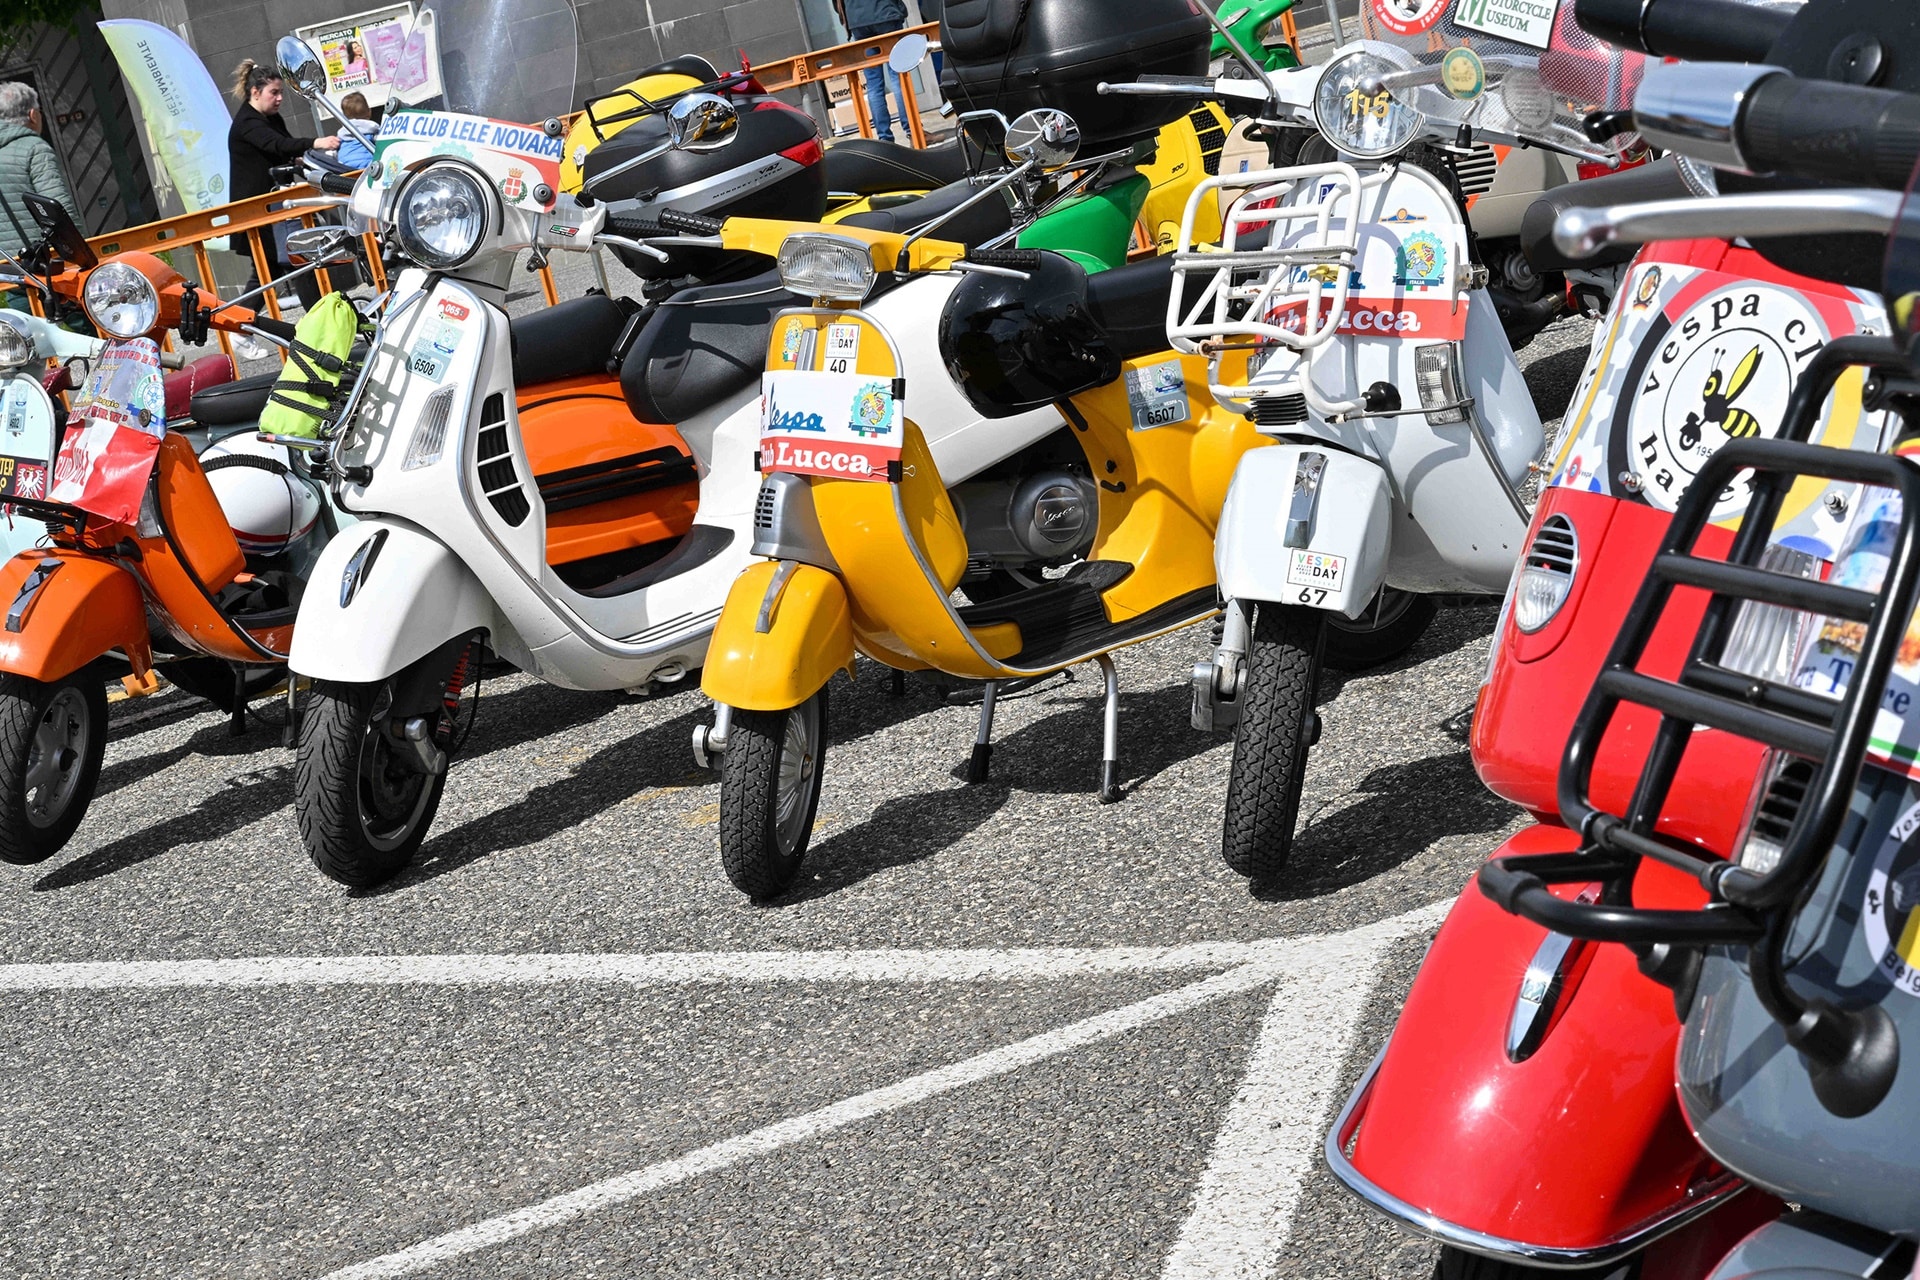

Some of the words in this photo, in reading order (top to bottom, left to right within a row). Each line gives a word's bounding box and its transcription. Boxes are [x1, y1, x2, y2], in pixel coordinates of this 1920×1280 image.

[334, 82, 343, 90] 14
[412, 115, 448, 138] CLUB
[450, 119, 486, 143] LELE
[490, 126, 563, 158] NOVARA
[831, 327, 855, 339] VESPA
[838, 338, 854, 349] DAY
[1642, 293, 1761, 396] vespa
[414, 358, 436, 376] 6508
[830, 359, 847, 374] 40
[1126, 367, 1151, 379] VESPA
[1128, 381, 1154, 394] DAYS
[768, 382, 827, 433] Vespa
[1147, 406, 1176, 425] 6507
[776, 441, 872, 476] Lucca
[1298, 553, 1339, 570] VESPA
[1312, 566, 1338, 580] DAY
[1298, 587, 1328, 606] 67
[1826, 657, 1912, 716] Tre
